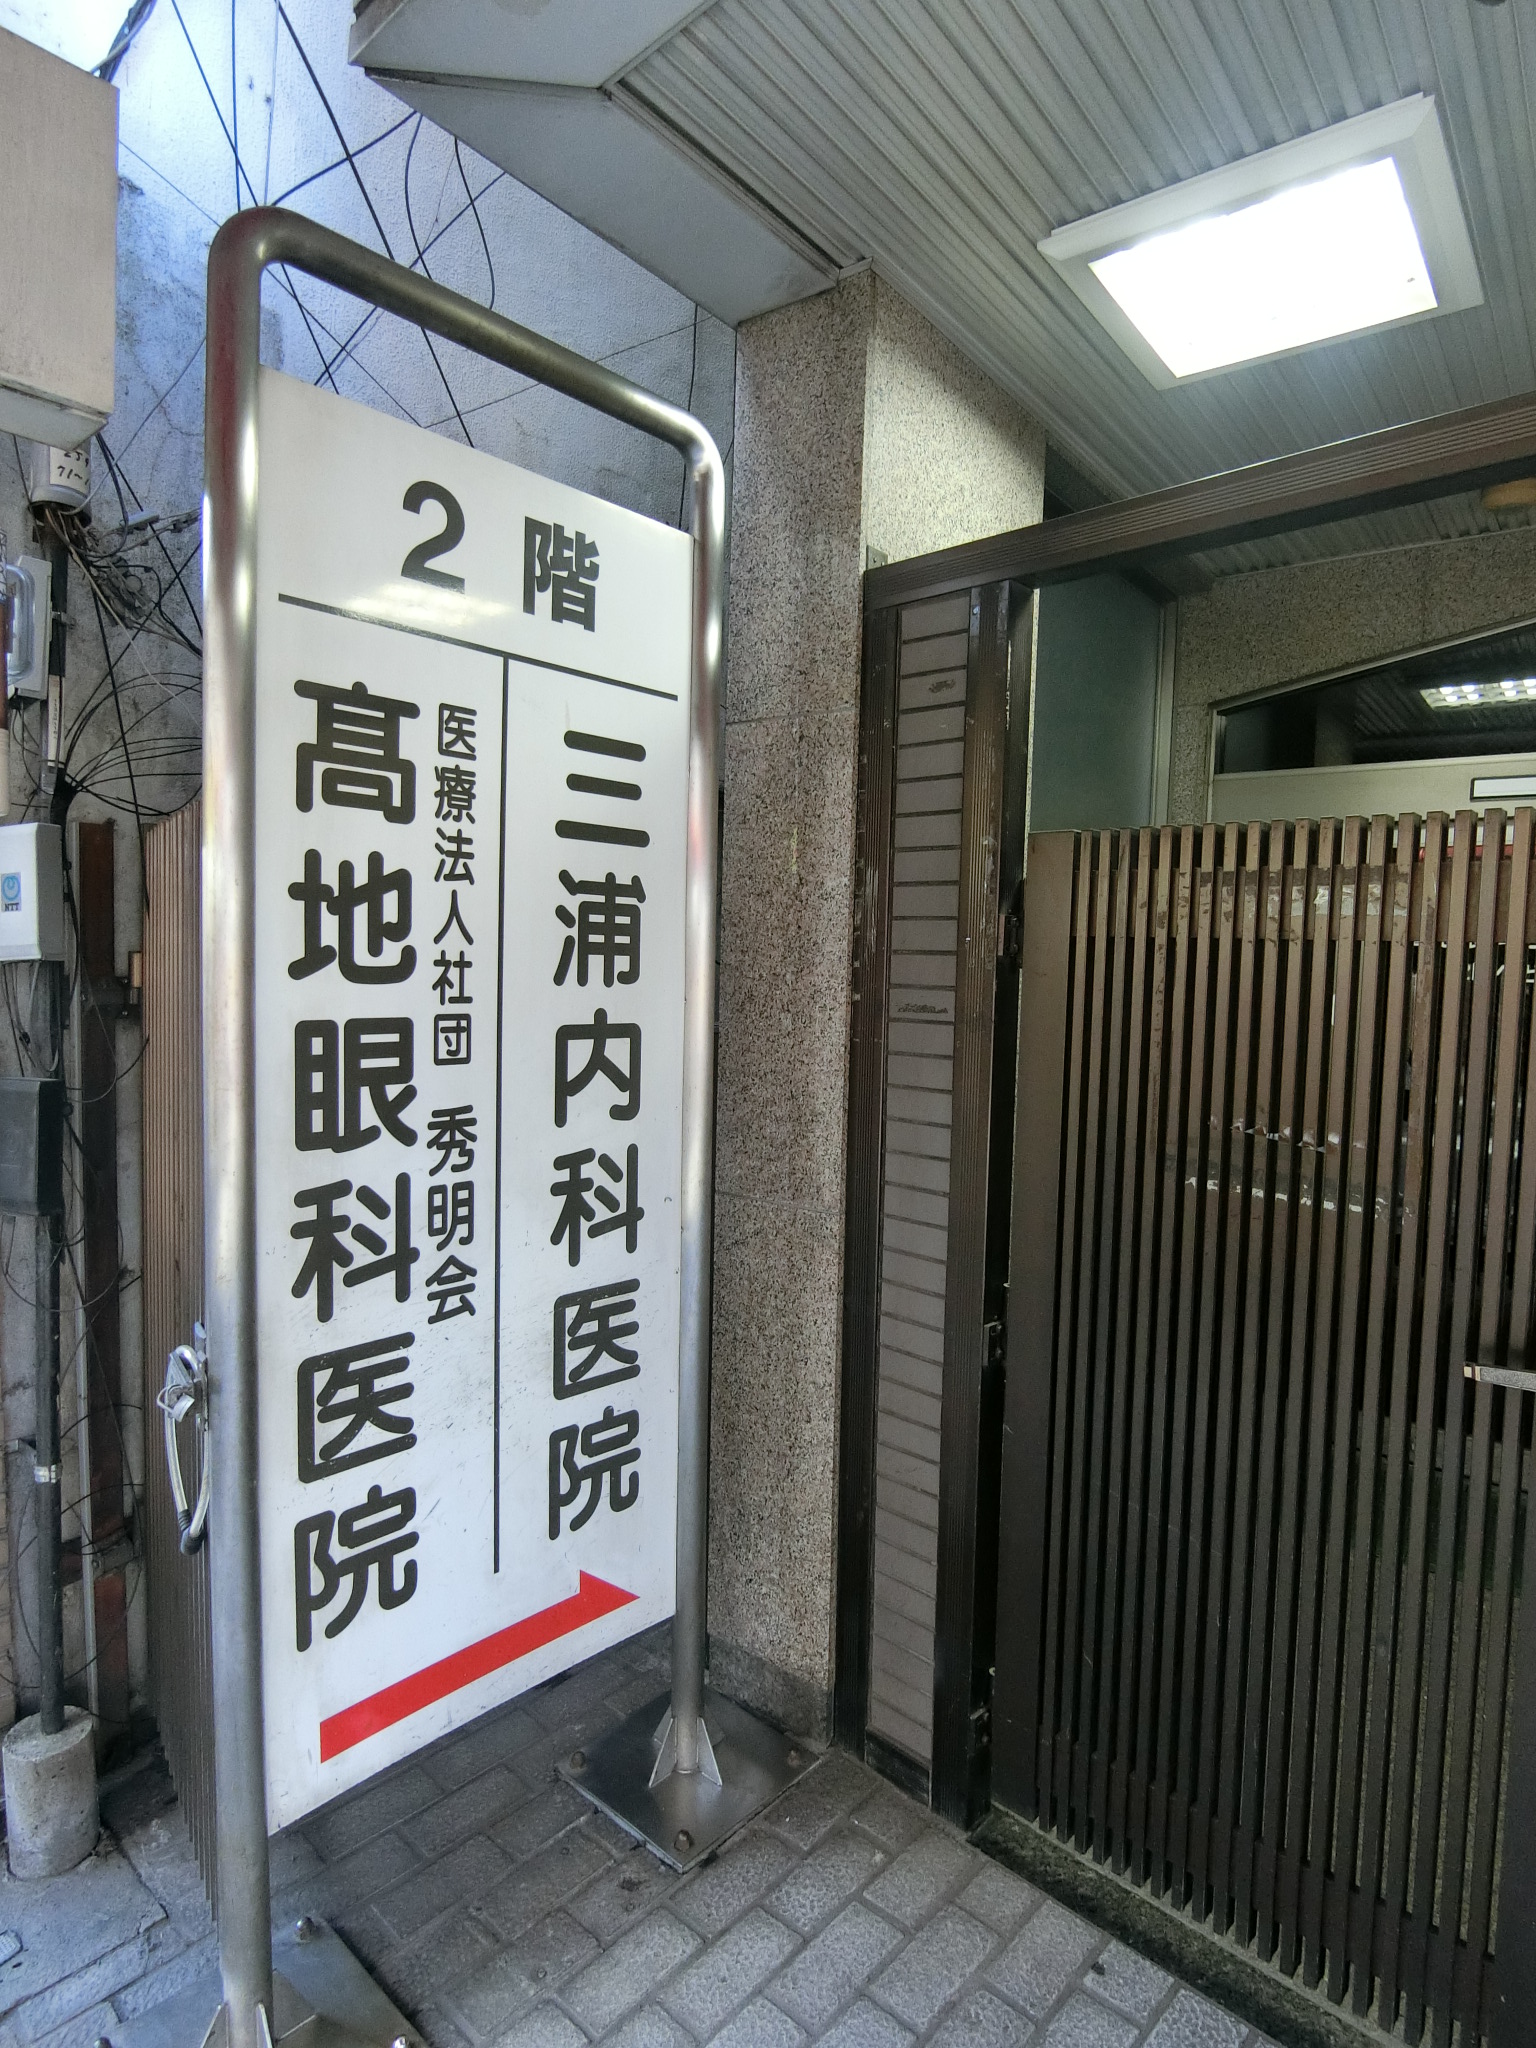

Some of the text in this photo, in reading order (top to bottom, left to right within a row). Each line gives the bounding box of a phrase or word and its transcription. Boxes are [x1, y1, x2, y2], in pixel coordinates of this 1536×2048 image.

[4, 902, 19, 911] NTT
[426, 703, 477, 1324] 医療法人社団 秀明会
[549, 731, 650, 1540] 三浦内科医院
